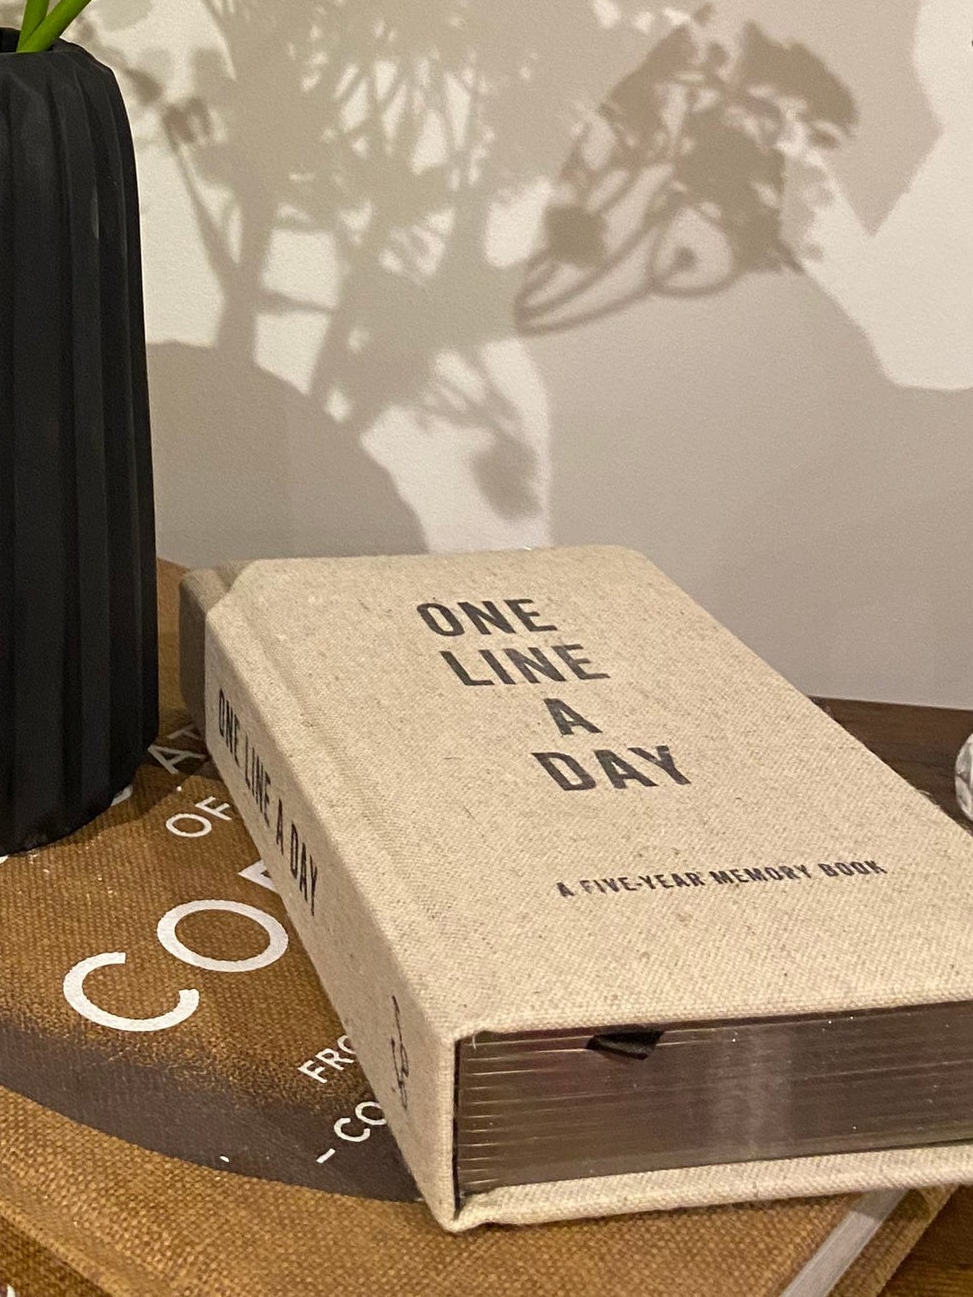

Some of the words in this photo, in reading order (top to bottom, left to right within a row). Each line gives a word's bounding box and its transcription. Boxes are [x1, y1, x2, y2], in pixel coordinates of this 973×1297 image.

[417, 599, 557, 637] ONE
[440, 645, 609, 686] LINE
[543, 698, 602, 735] A
[531, 745, 692, 792] DAY
[165, 795, 233, 838] OF
[218, 686, 240, 768] ONE
[244, 732, 271, 828] LINE
[276, 798, 284, 856] A
[290, 820, 318, 917] DAY
[556, 881, 575, 898] A
[579, 869, 706, 896] FIVE-YEAR
[708, 863, 812, 886] MEMORY
[817, 859, 888, 879] BOOK
[297, 1034, 356, 1084] FRO
